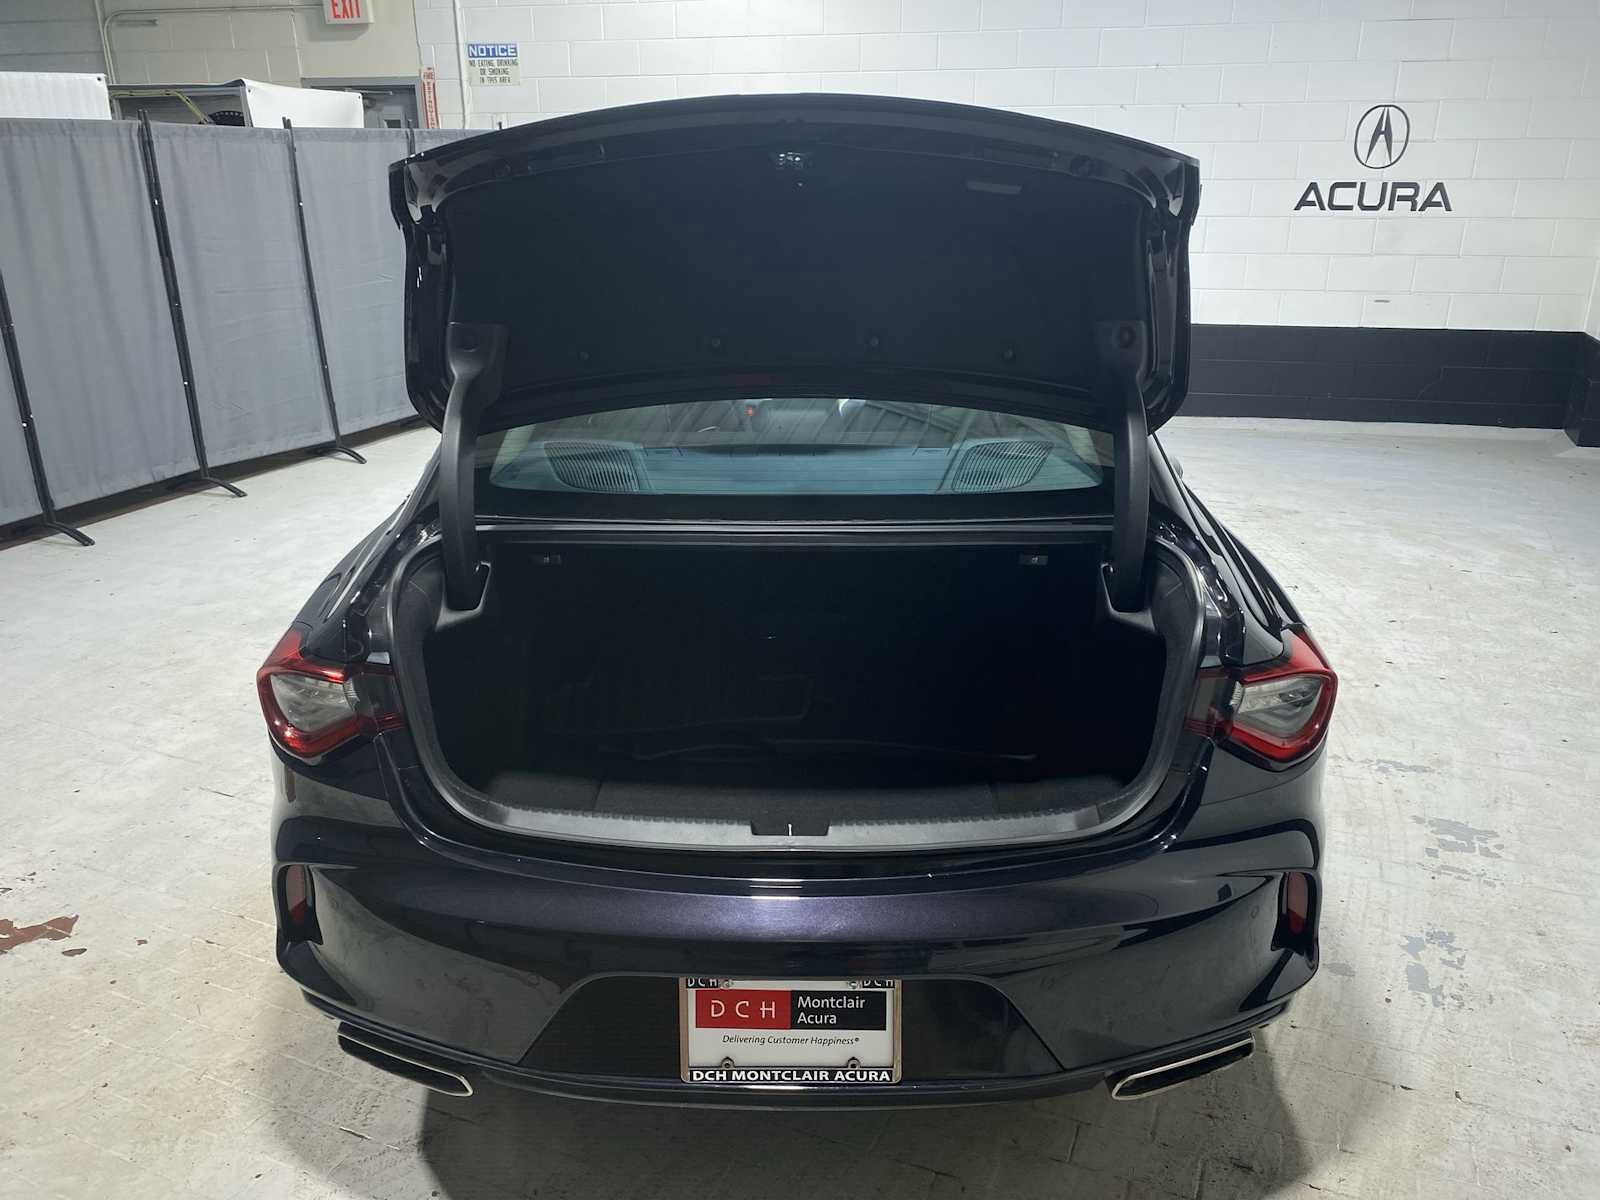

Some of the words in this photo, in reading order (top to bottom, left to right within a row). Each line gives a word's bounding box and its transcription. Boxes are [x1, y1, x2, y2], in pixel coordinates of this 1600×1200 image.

[331, 0, 361, 19] EXIT
[469, 45, 517, 57] NOTICE
[469, 59, 476, 67] NO
[1294, 182, 1452, 211] ACURA
[797, 996, 866, 1009] Montclair
[711, 1000, 776, 1019] DCH
[797, 1013, 837, 1025] Acura
[722, 1034, 765, 1045] Delivering
[767, 1036, 808, 1044] Customer
[693, 1071, 727, 1081] DCH
[732, 1071, 829, 1081] MONTCLAIR
[834, 1071, 890, 1081] ACURA
